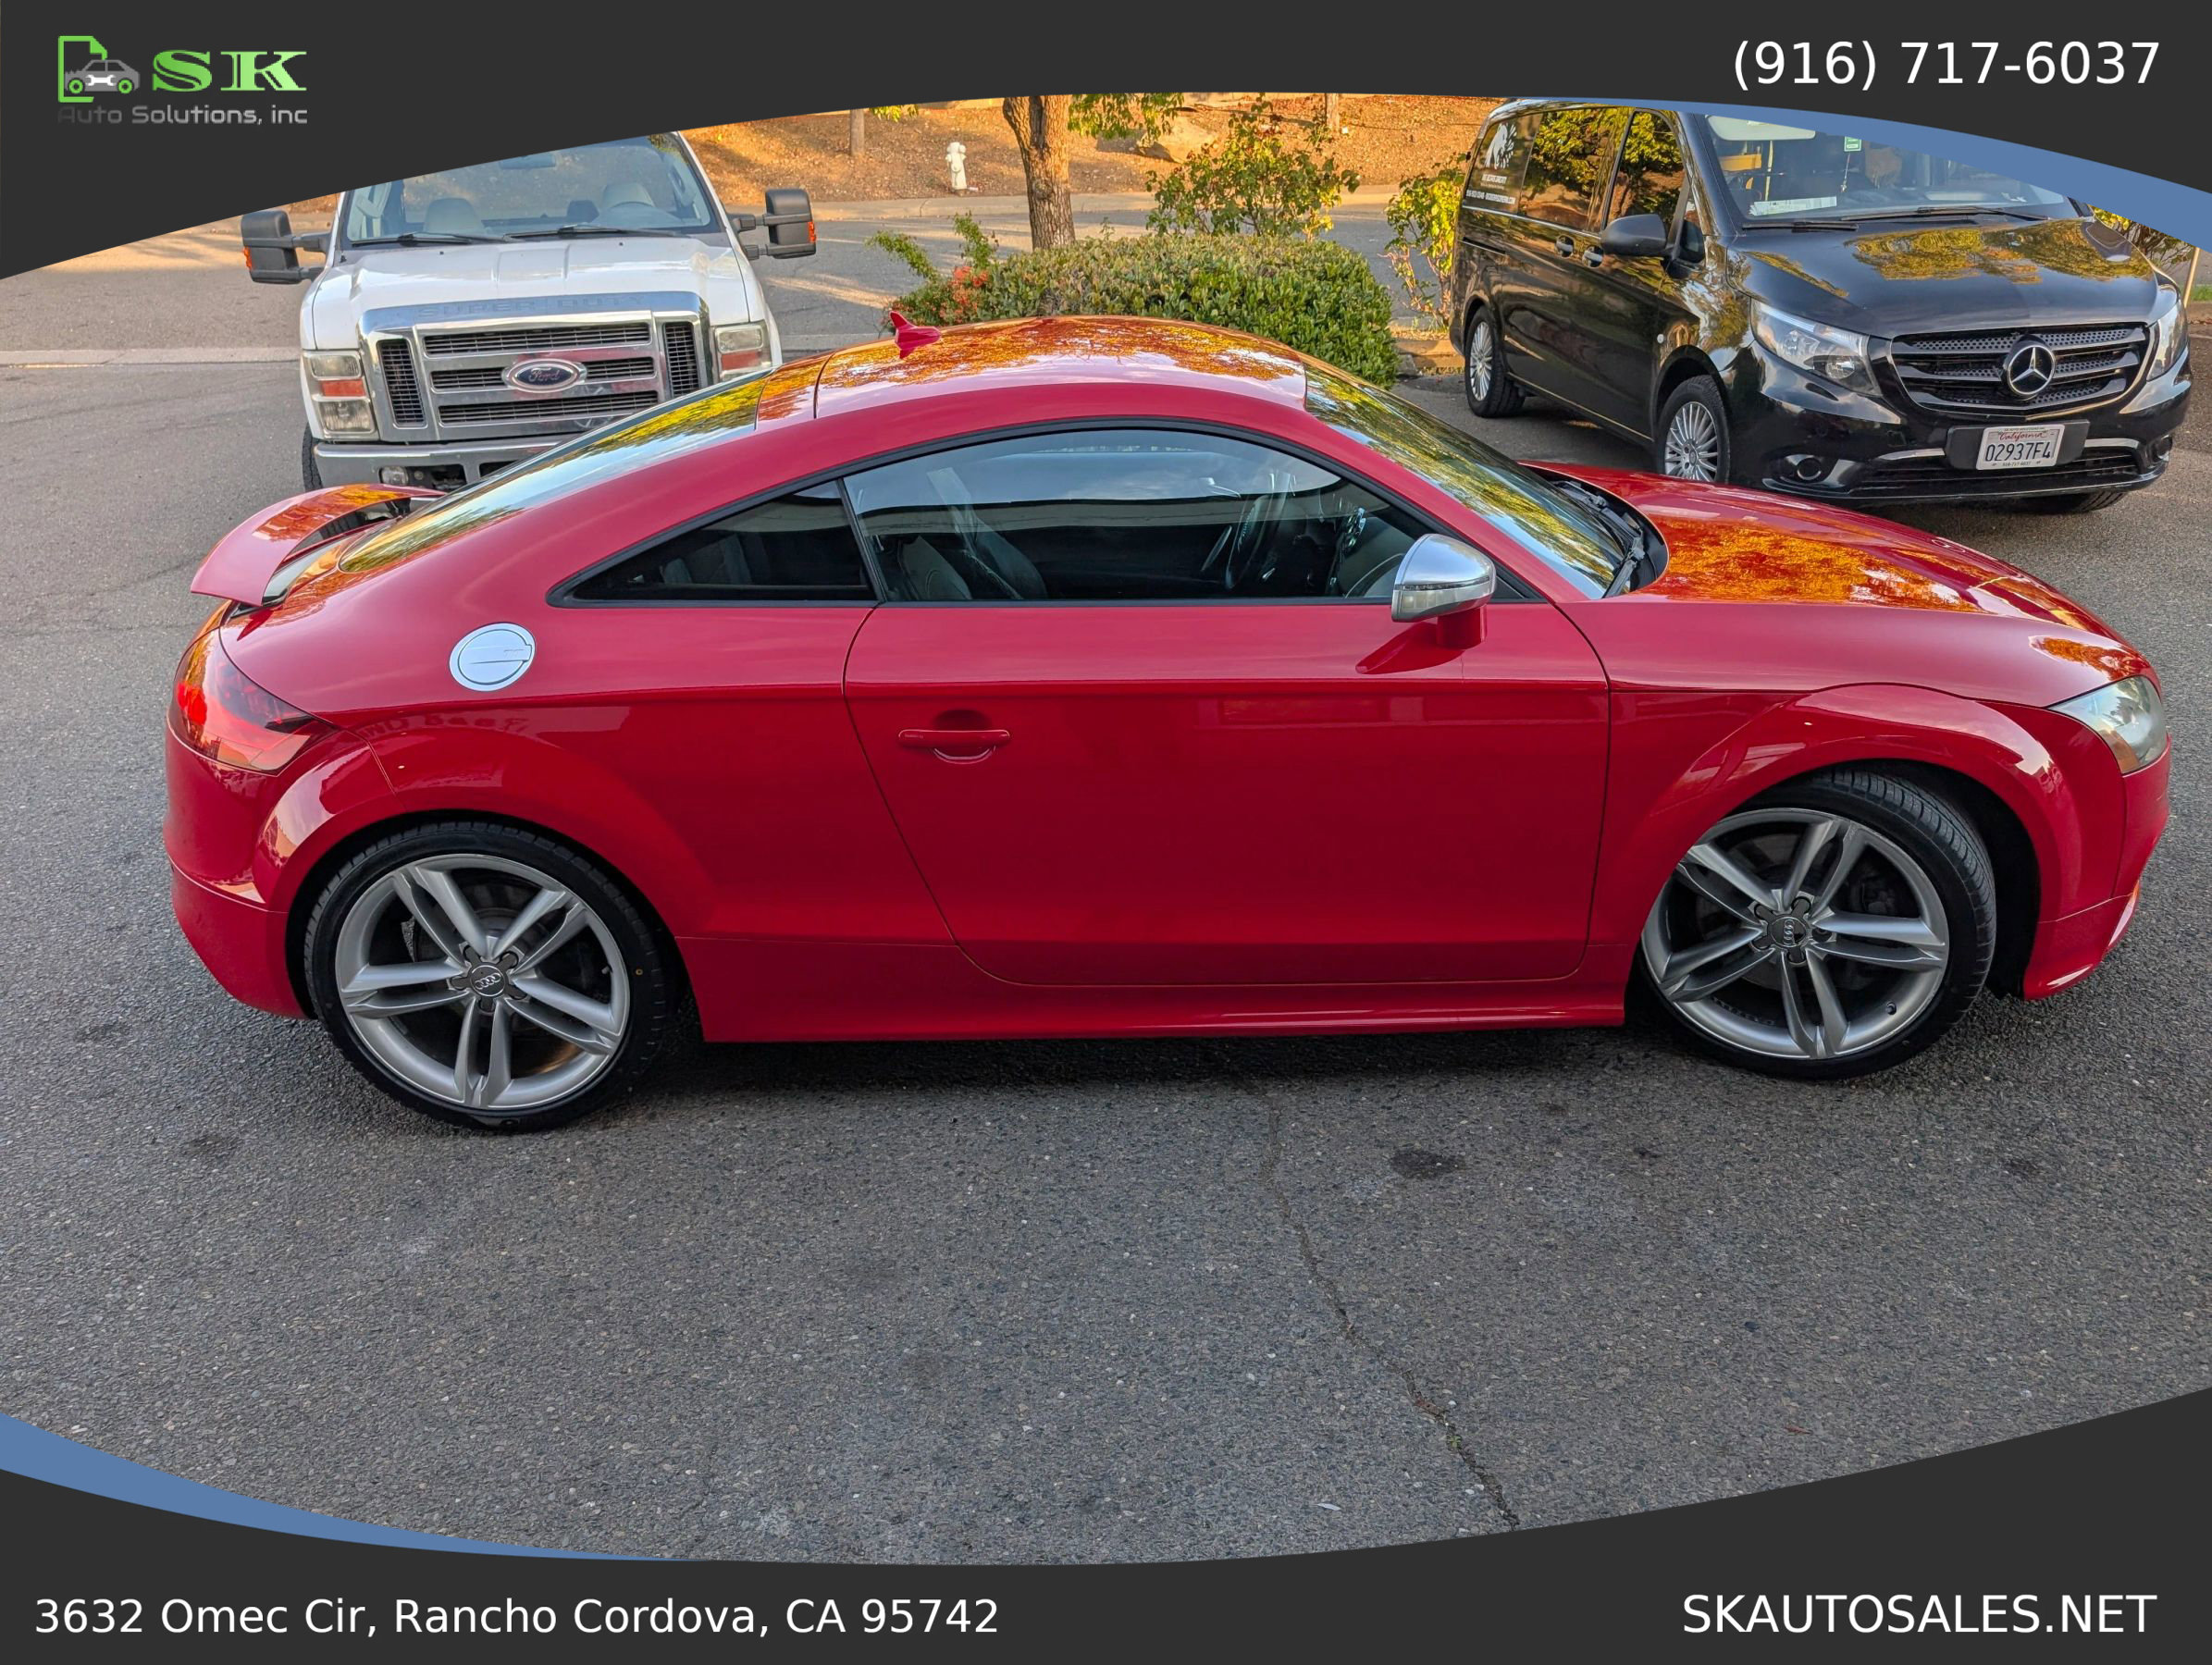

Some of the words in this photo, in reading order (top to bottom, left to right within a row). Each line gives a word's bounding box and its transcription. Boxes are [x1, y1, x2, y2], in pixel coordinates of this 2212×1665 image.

[417, 300, 537, 318] SUPER
[557, 295, 644, 309] DUTY
[528, 366, 561, 382] Ford
[1999, 431, 2046, 441] California
[1984, 441, 2051, 462] 02937F4
